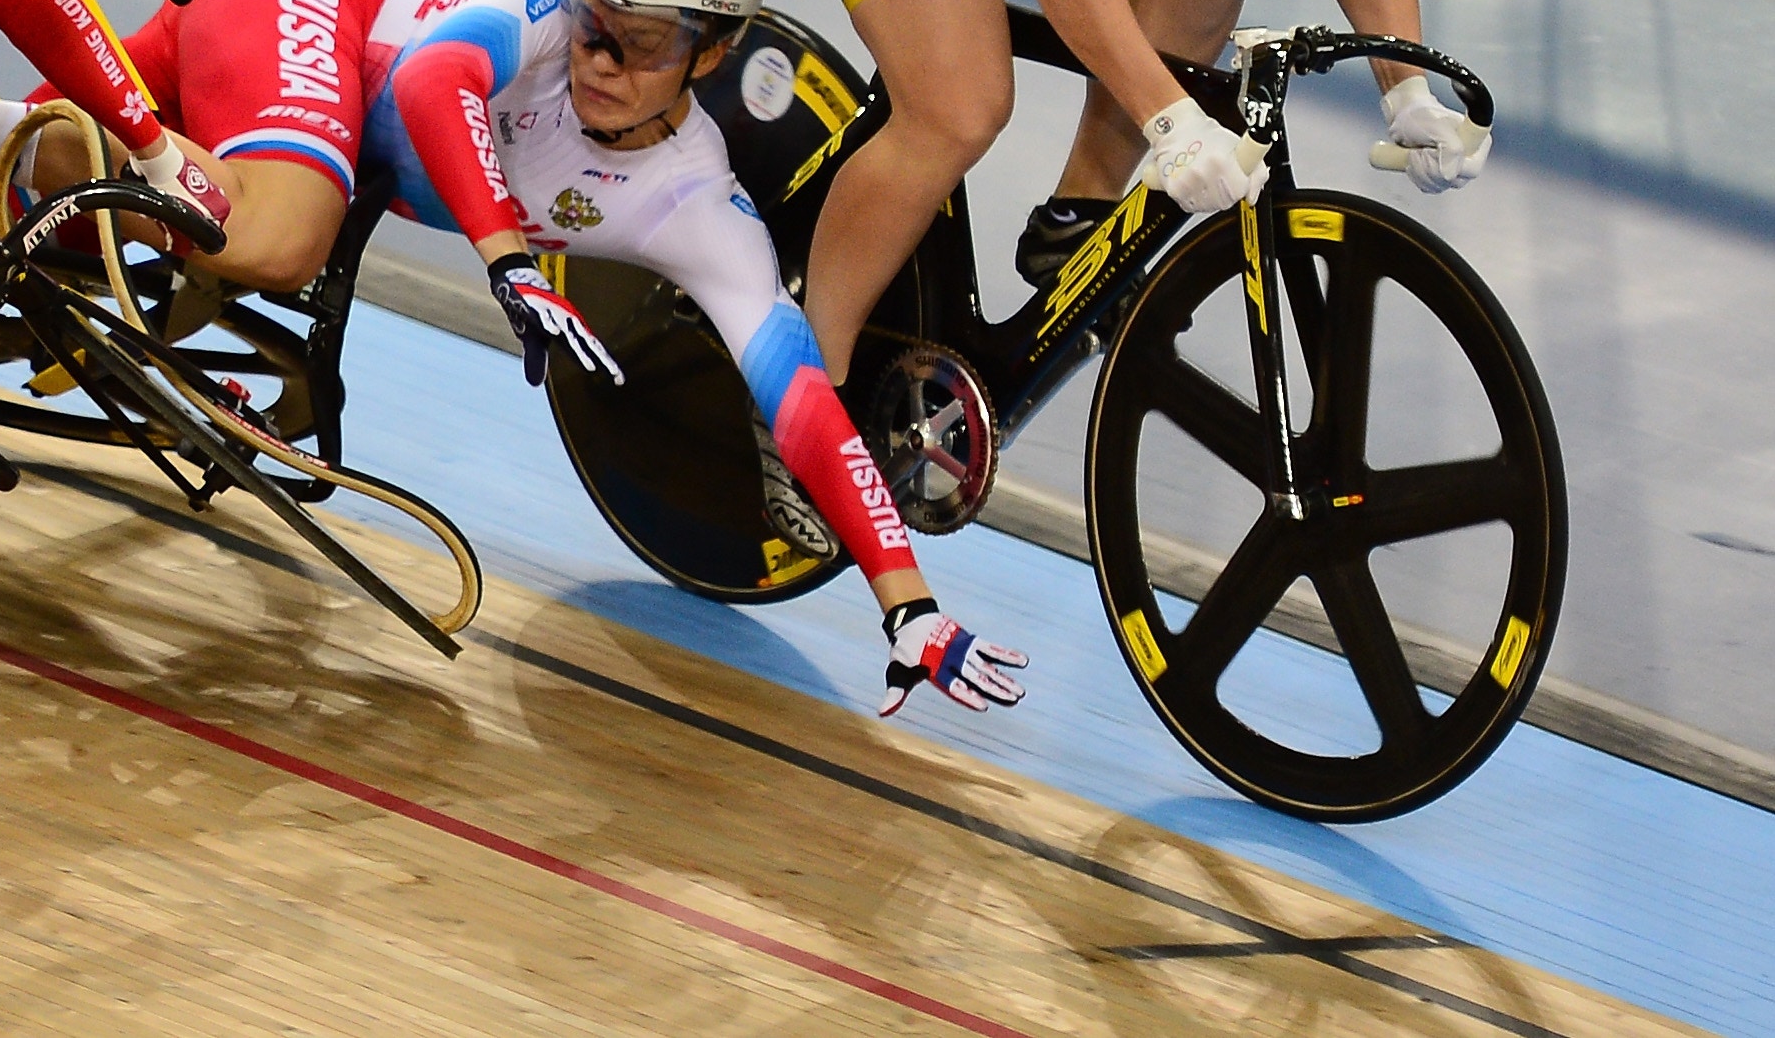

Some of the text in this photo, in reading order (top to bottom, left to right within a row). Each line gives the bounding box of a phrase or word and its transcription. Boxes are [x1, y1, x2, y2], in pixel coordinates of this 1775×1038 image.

[85, 28, 125, 87] HONG
[1245, 101, 1274, 128] 3T
[458, 88, 509, 204] RUSSIA
[24, 202, 81, 256] ALPINA
[839, 435, 911, 551] RUSSIA
